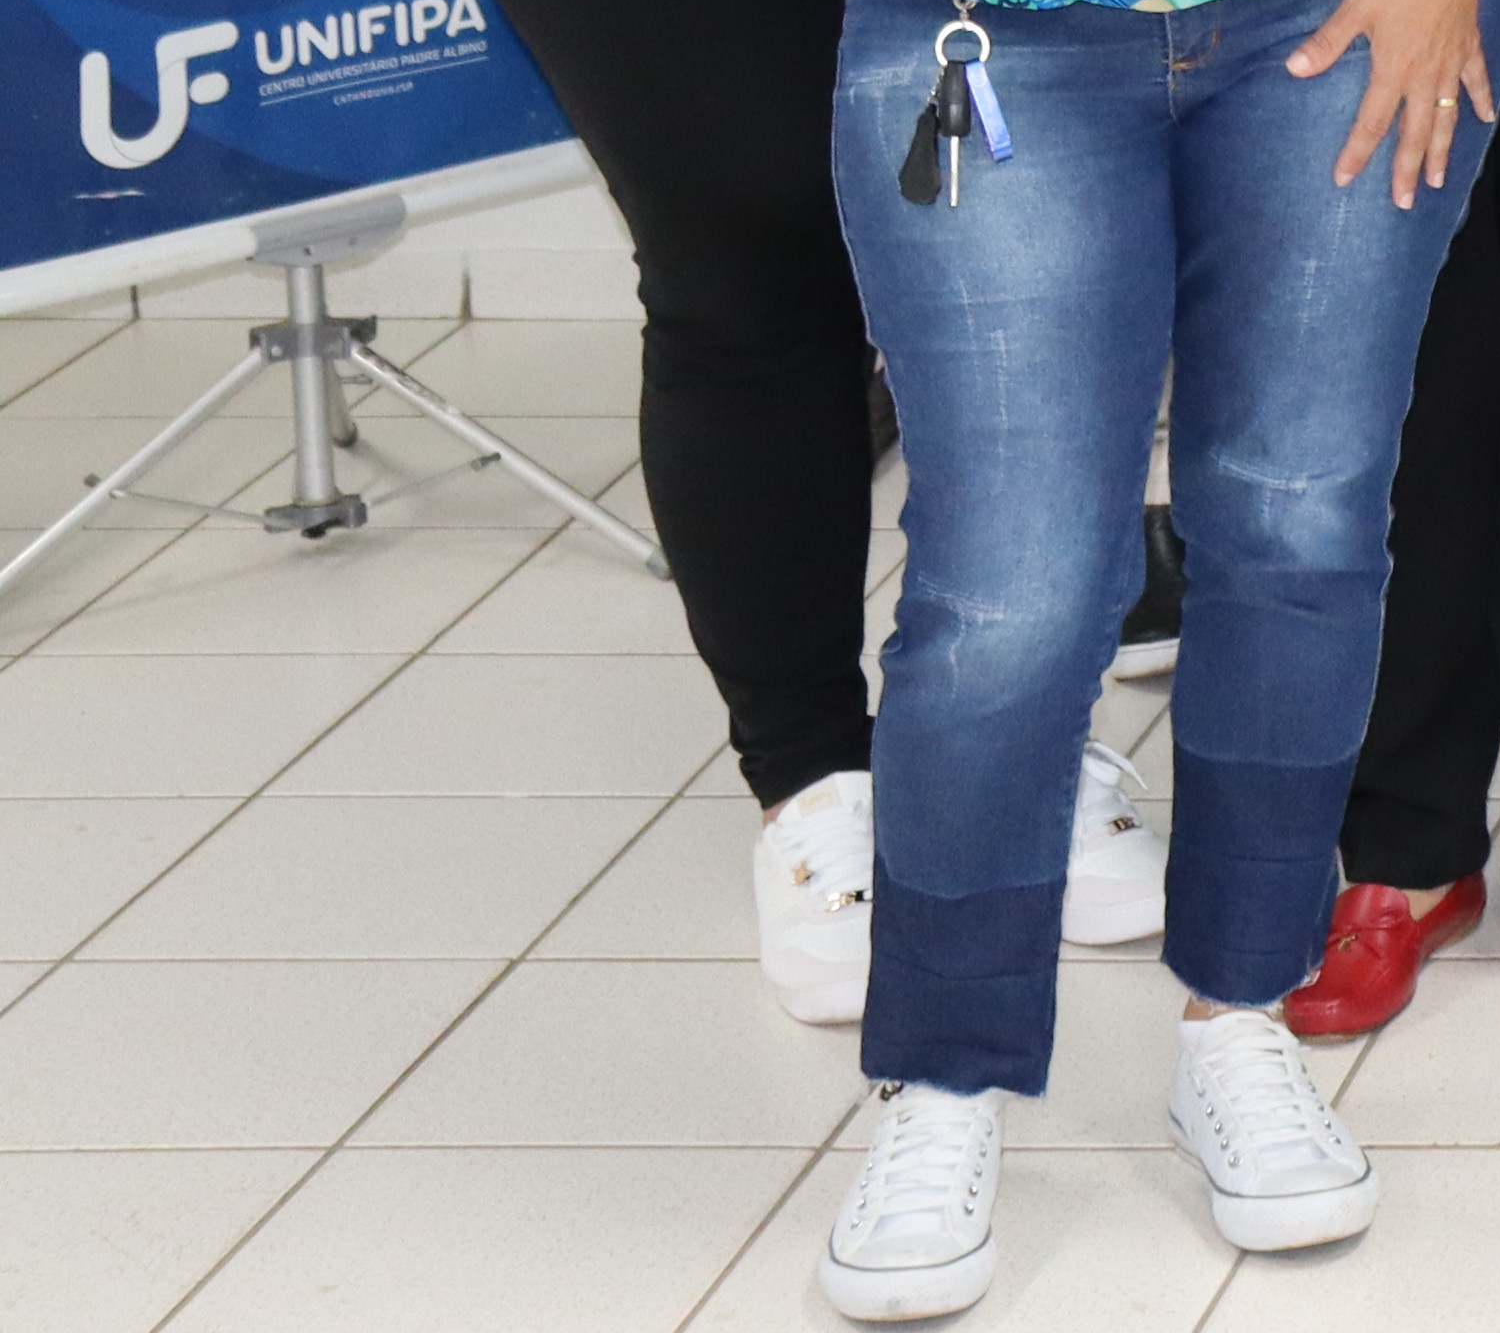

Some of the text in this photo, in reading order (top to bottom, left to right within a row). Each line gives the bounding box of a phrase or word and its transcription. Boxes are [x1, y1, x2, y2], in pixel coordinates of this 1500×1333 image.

[80, 21, 239, 170] UF
[259, 40, 487, 97] CENTRO UNIVERSITÁRIO PADRE ALBINO
